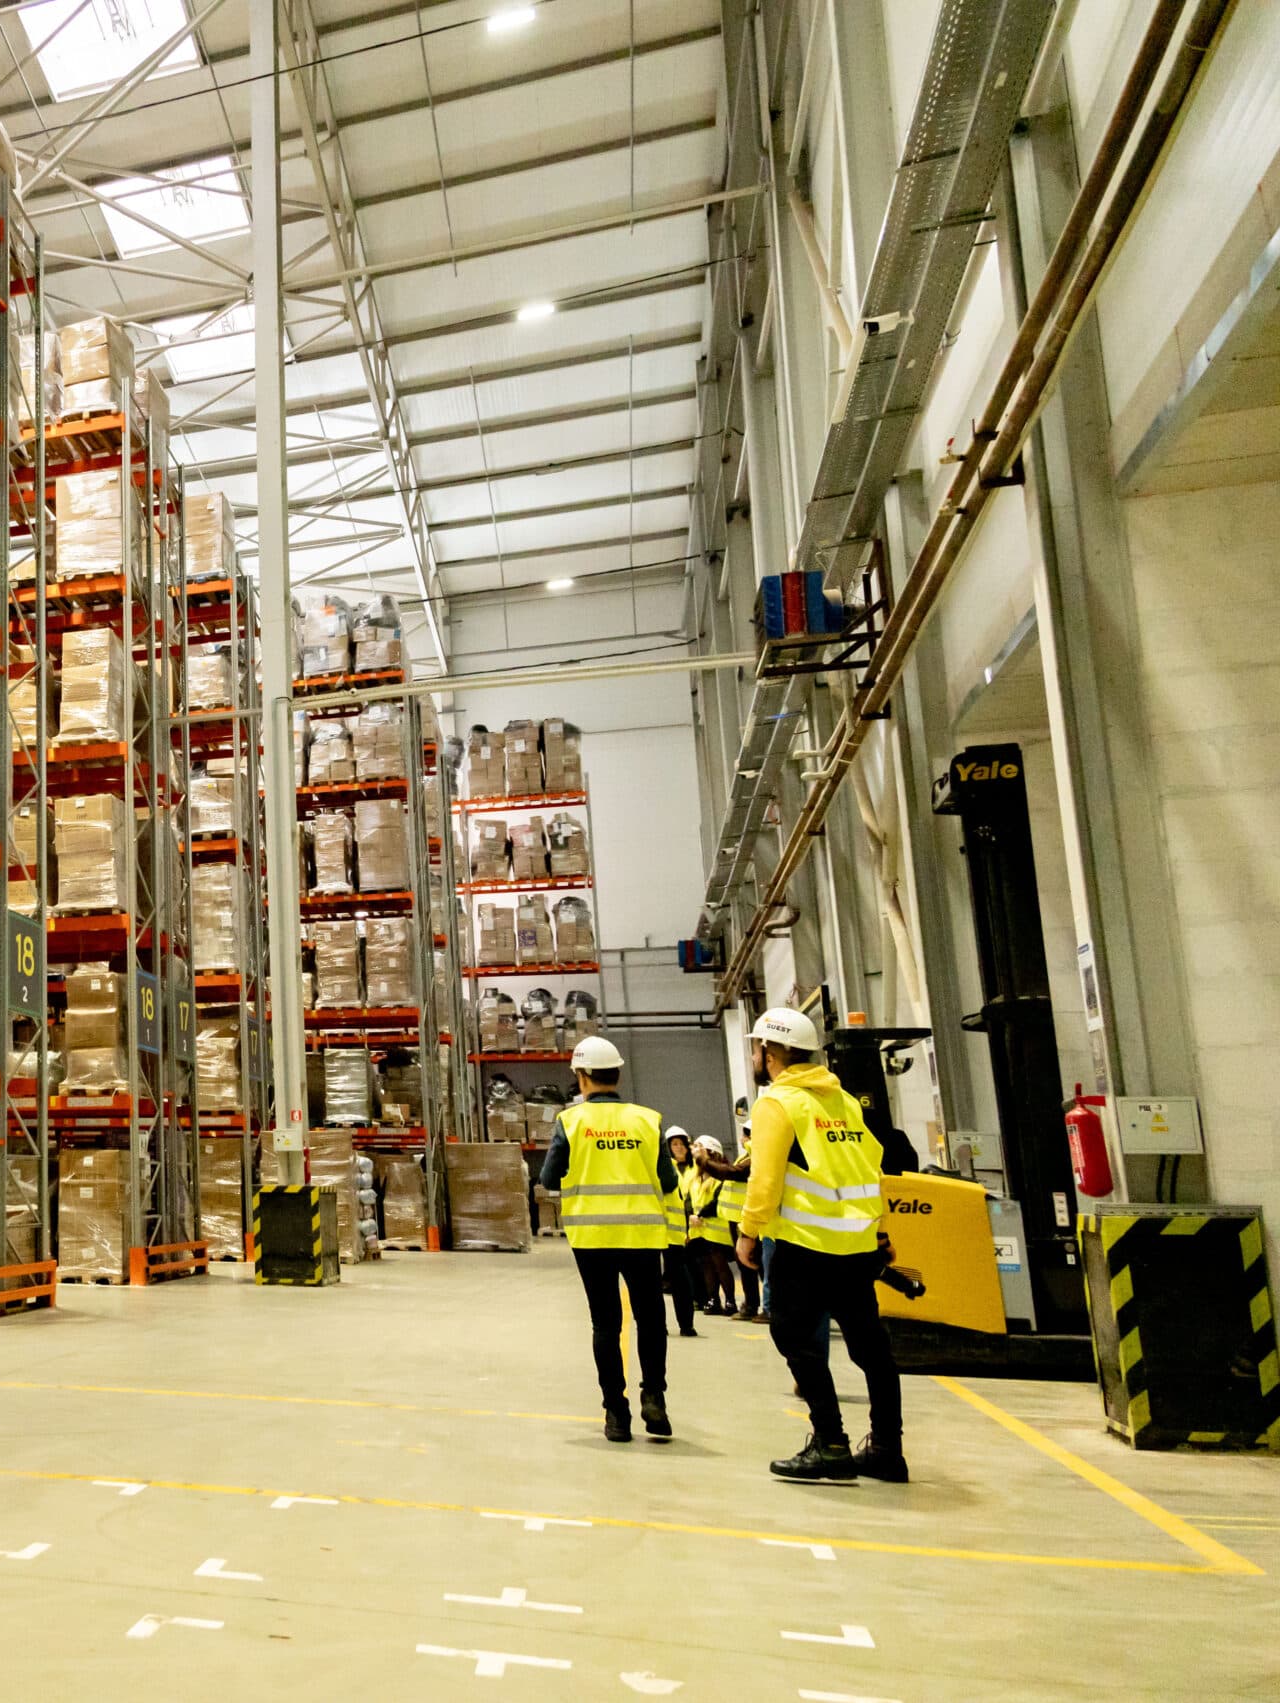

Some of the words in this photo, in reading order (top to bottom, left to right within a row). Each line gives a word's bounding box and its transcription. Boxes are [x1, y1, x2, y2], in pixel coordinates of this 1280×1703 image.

[956, 760, 1019, 782] Yale
[15, 933, 35, 976] 18
[22, 985, 29, 1002] 2
[141, 986, 154, 1020] 18
[179, 1001, 190, 1031] 17
[766, 1023, 792, 1034] GUEST
[860, 1095, 870, 1107] 6
[584, 1128, 627, 1138] Aurora
[596, 1139, 642, 1150] GUEST
[887, 1198, 933, 1214] Yale
